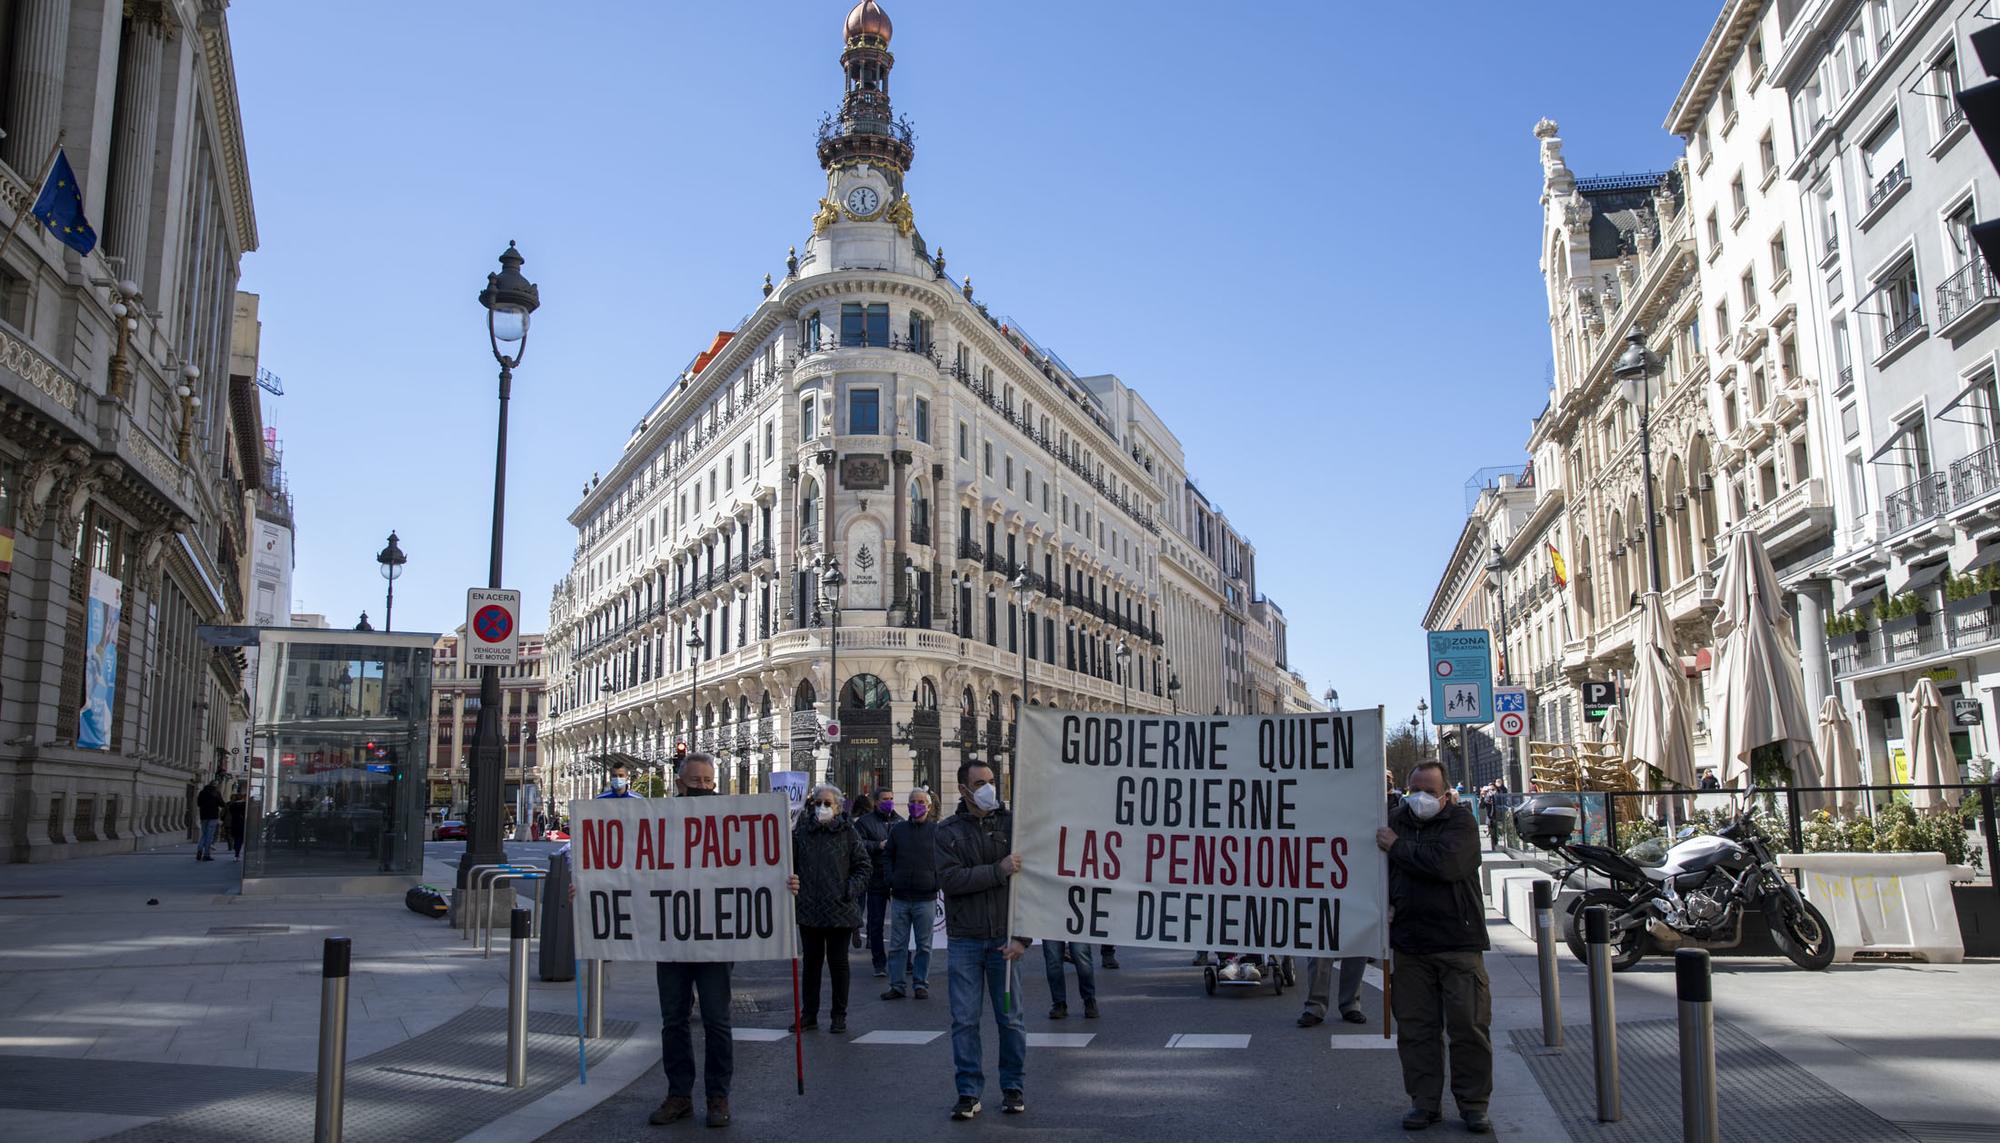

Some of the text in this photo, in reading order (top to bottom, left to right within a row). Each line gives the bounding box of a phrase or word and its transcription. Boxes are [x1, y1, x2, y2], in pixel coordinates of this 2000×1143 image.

[1452, 636, 1486, 645] ZONA
[1591, 684, 1606, 703] P
[1956, 699, 1977, 710] ATM
[243, 728, 252, 772] HOTEL
[1061, 715, 1354, 773] GOBIERNE QUIEN
[1507, 720, 1518, 729] 10
[1115, 775, 1298, 831] GOBIERNE
[582, 814, 781, 870] NO AL PACTO
[1057, 826, 1349, 890] LAS PENSIONES
[589, 886, 773, 942] DE TOLEDO
[1066, 885, 1341, 952] SE DEFIENDEN
